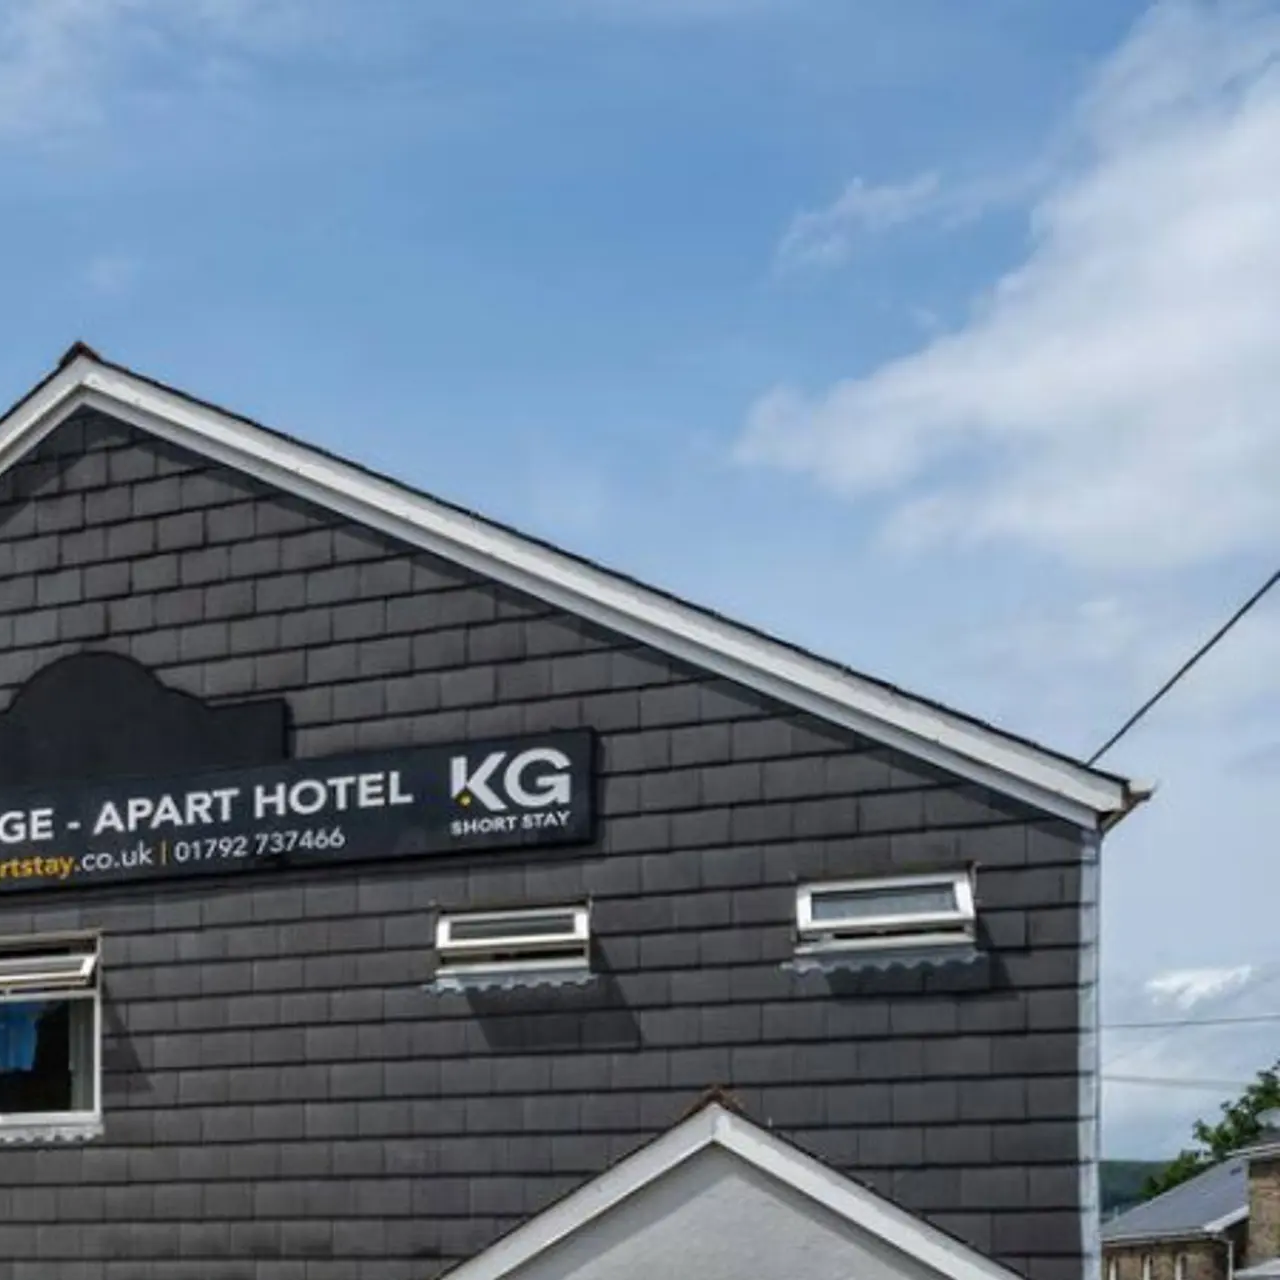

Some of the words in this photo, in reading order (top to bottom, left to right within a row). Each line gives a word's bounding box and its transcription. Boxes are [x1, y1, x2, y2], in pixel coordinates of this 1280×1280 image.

[92, 787, 240, 836] APART
[254, 770, 413, 819] HOTEL
[450, 748, 572, 811] KG
[174, 836, 248, 862] 01792
[255, 827, 345, 856] 737466
[451, 815, 516, 836] SHORT
[522, 810, 571, 829] STAY
